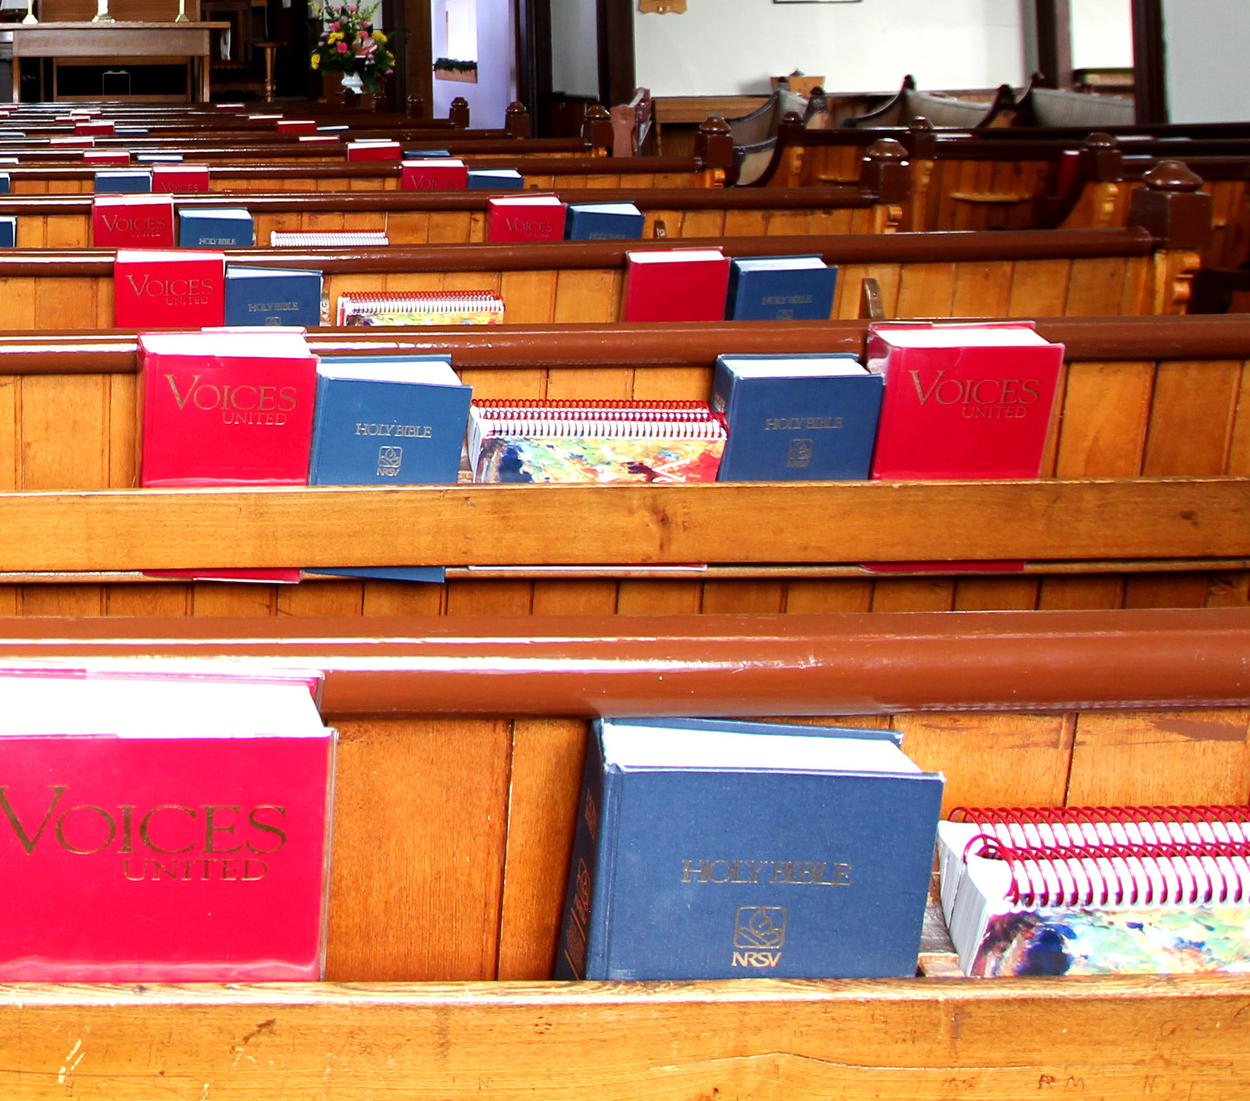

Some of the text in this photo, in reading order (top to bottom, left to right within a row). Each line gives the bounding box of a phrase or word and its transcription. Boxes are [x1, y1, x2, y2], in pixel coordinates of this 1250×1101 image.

[101, 215, 166, 231] VOICES
[506, 219, 553, 232] VOICES
[125, 274, 215, 298] VOICES
[166, 296, 209, 306] UNITED
[249, 301, 274, 313] HOLY
[163, 374, 299, 411] VOICES
[909, 369, 1042, 407] VOICES
[222, 411, 289, 427] UNITED
[962, 405, 1029, 420] UNITED
[355, 422, 433, 439] HOLY BIBLE
[766, 417, 844, 432] HOLY BIBLE
[377, 468, 401, 478] NRSV
[122, 858, 269, 882] UNITED
[681, 859, 852, 887] HOLY BIBLE
[731, 951, 783, 968] NRSV
